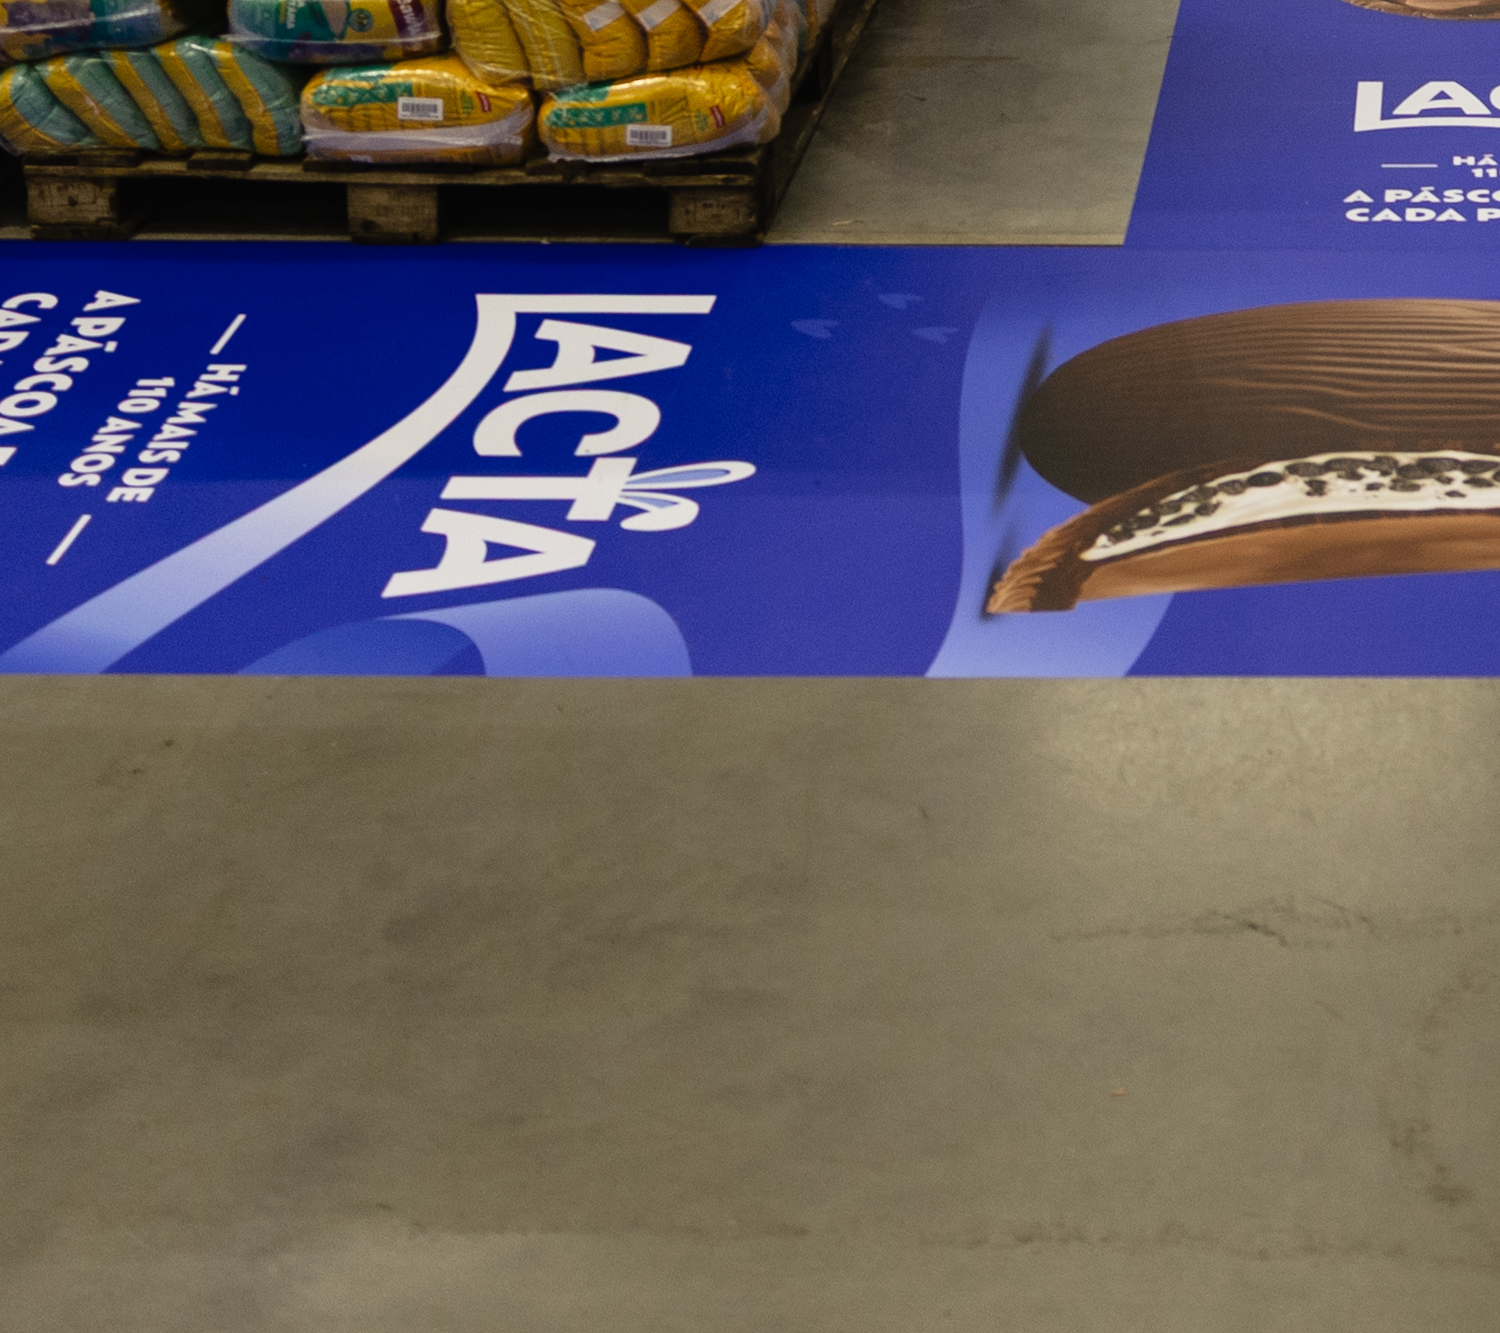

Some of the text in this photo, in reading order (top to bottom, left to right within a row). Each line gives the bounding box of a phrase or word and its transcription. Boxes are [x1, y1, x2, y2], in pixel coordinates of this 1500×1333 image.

[1453, 154, 1498, 166] HÁ
[1343, 189, 1374, 203] A
[1345, 208, 1468, 222] CADA
[83, 290, 142, 312] A
[58, 376, 175, 488] 110 ANOS
[106, 363, 247, 503] HÁ MAIS DE
[382, 293, 718, 599] LACTA
